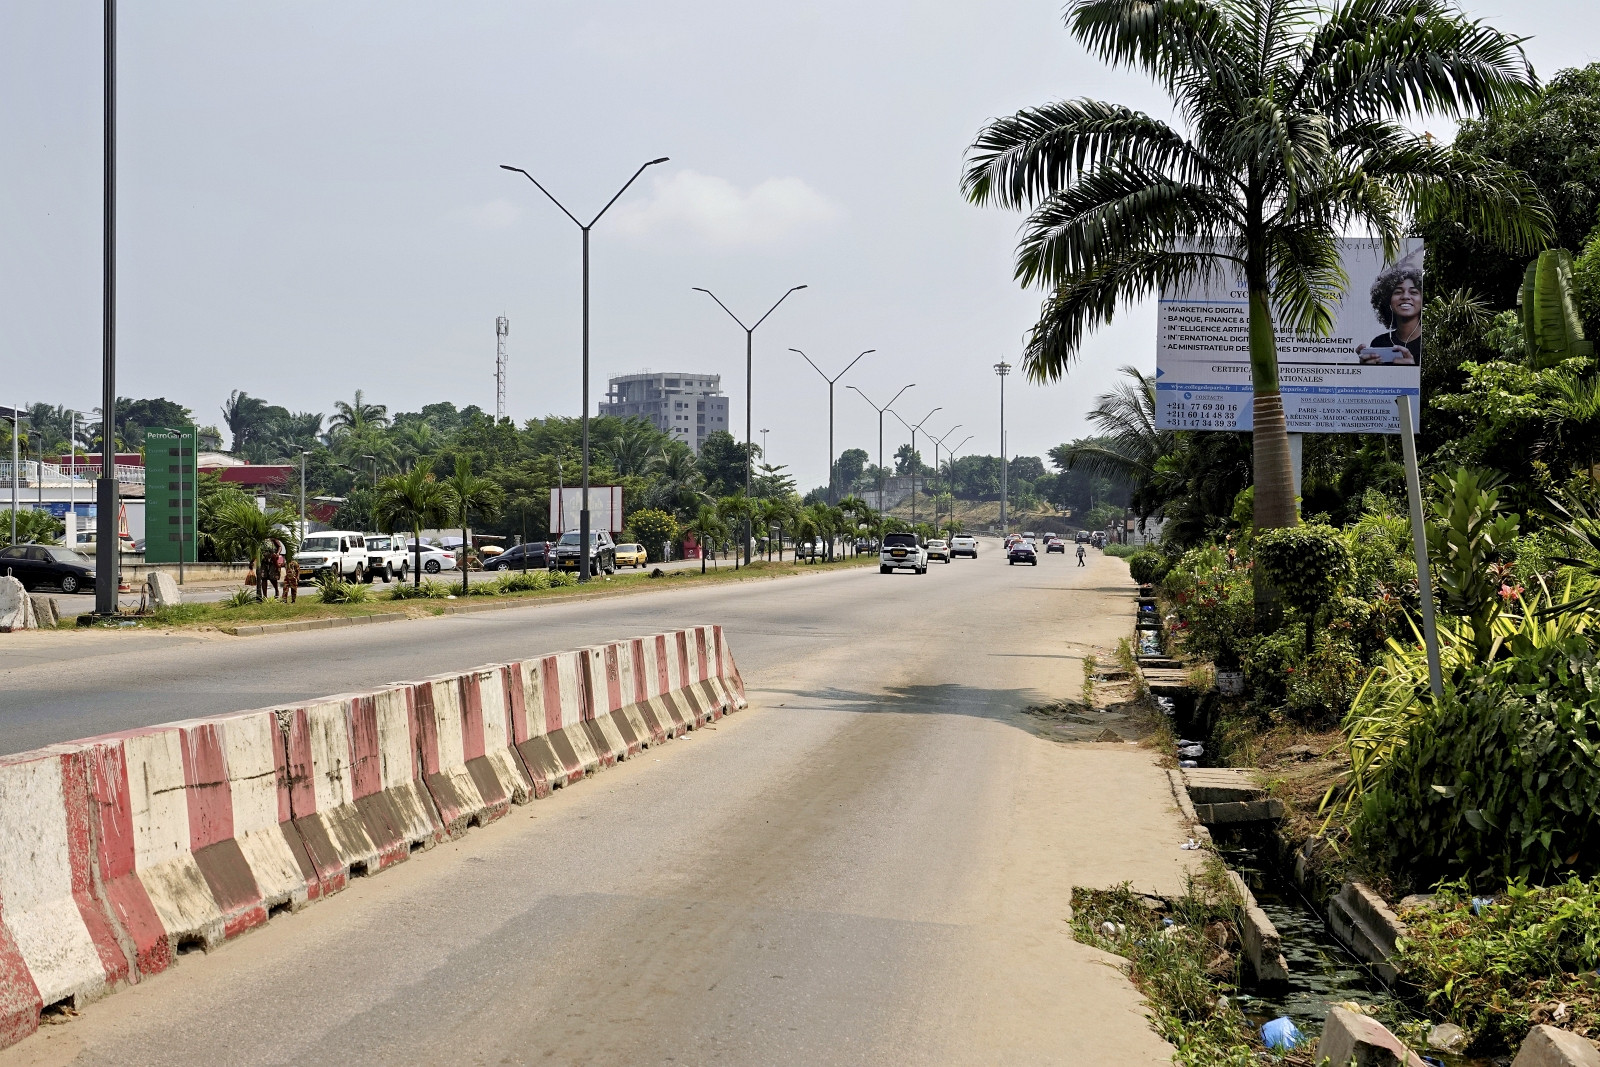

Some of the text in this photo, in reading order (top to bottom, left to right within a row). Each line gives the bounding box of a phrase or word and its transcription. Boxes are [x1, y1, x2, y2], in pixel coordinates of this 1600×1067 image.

[1168, 315, 1203, 323] BANQUE,
[1293, 346, 1354, 354] D'INFORMATION
[1280, 367, 1362, 375] PROFESSIONNELLES
[1203, 403, 1213, 411] 69
[1201, 411, 1210, 419] 14
[1225, 412, 1235, 420] 33
[1189, 419, 1200, 427] 47
[1214, 420, 1225, 428] 39
[1226, 420, 1237, 428] 39
